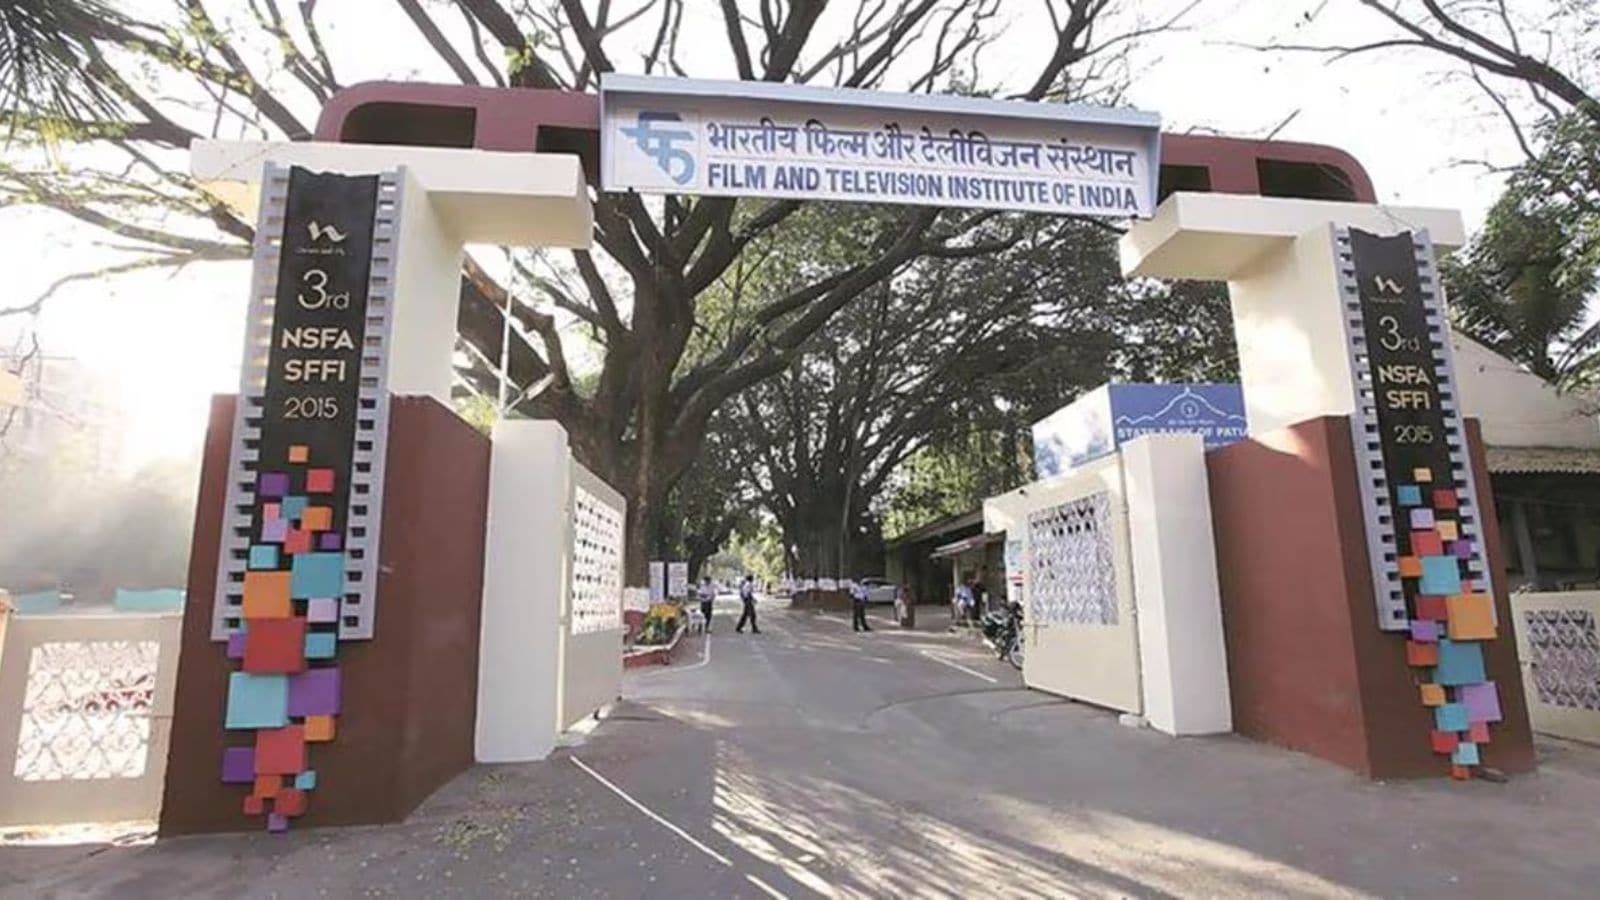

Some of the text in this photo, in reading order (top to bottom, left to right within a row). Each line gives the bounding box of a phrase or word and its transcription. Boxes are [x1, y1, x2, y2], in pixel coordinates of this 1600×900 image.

[706, 117, 1136, 177] भारतीय फिल्म और टेलीविजन संस्थान
[707, 163, 1139, 211] FILM AND TELEVISION INSTITUTE OF INDIA
[298, 269, 350, 310] 3rd
[281, 327, 355, 350] NSFA
[1379, 315, 1420, 351] 3rd
[284, 359, 346, 382] SFFI
[1377, 364, 1431, 385] NSFA
[283, 397, 339, 419] 2015
[1386, 390, 1431, 411] SFFI
[1393, 424, 1434, 444] 2015
